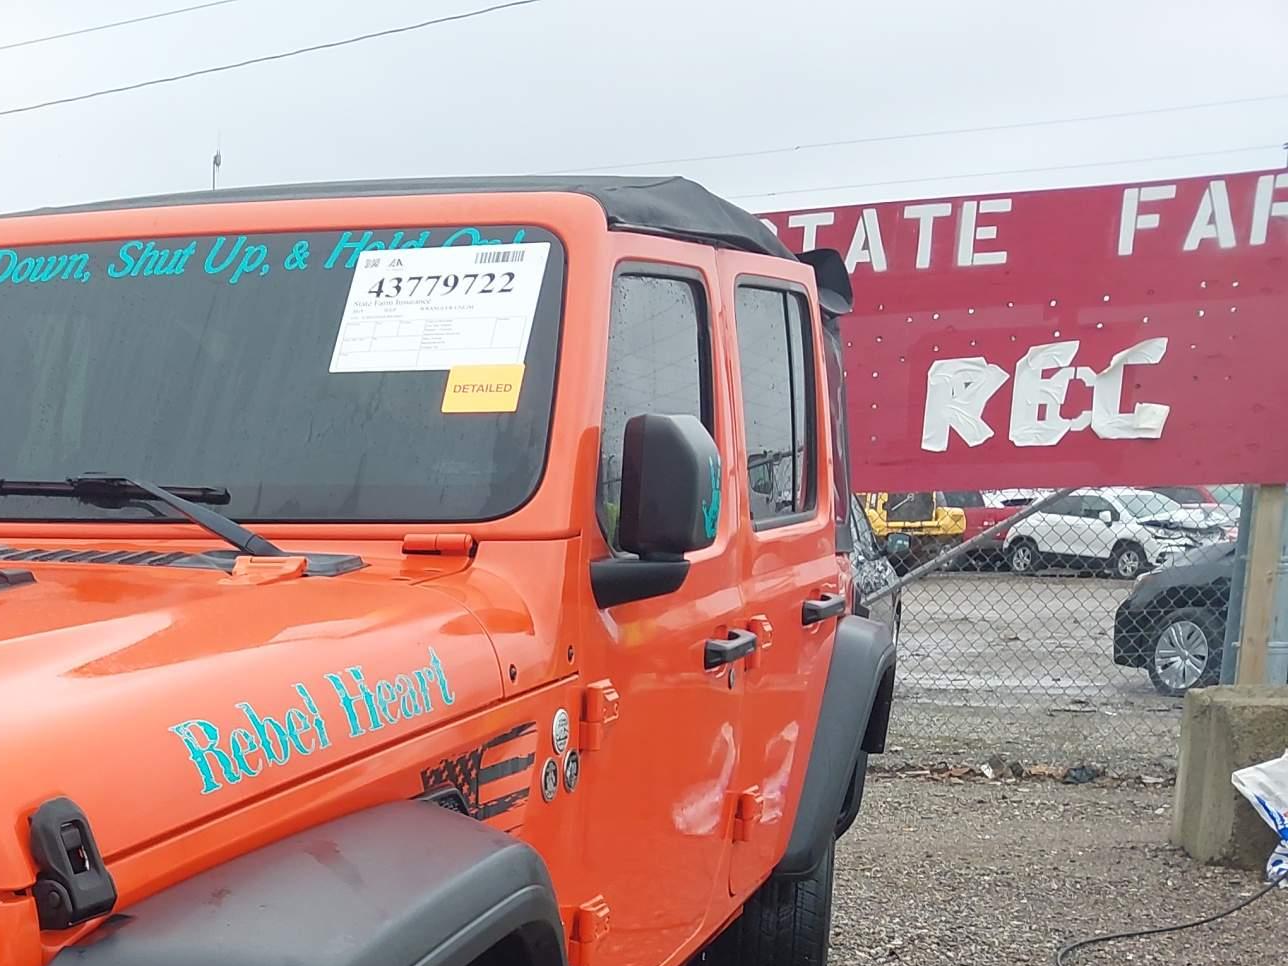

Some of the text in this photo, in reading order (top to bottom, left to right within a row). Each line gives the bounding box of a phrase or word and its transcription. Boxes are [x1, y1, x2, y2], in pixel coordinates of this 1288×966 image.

[107, 240, 197, 279] Shut
[204, 235, 270, 285] Up,
[284, 240, 312, 271] &
[759, 198, 1012, 274] TATE
[368, 271, 516, 298] 43779722
[453, 383, 513, 394] DETAILED
[168, 682, 332, 794] Rebel
[323, 646, 455, 737] Heart
